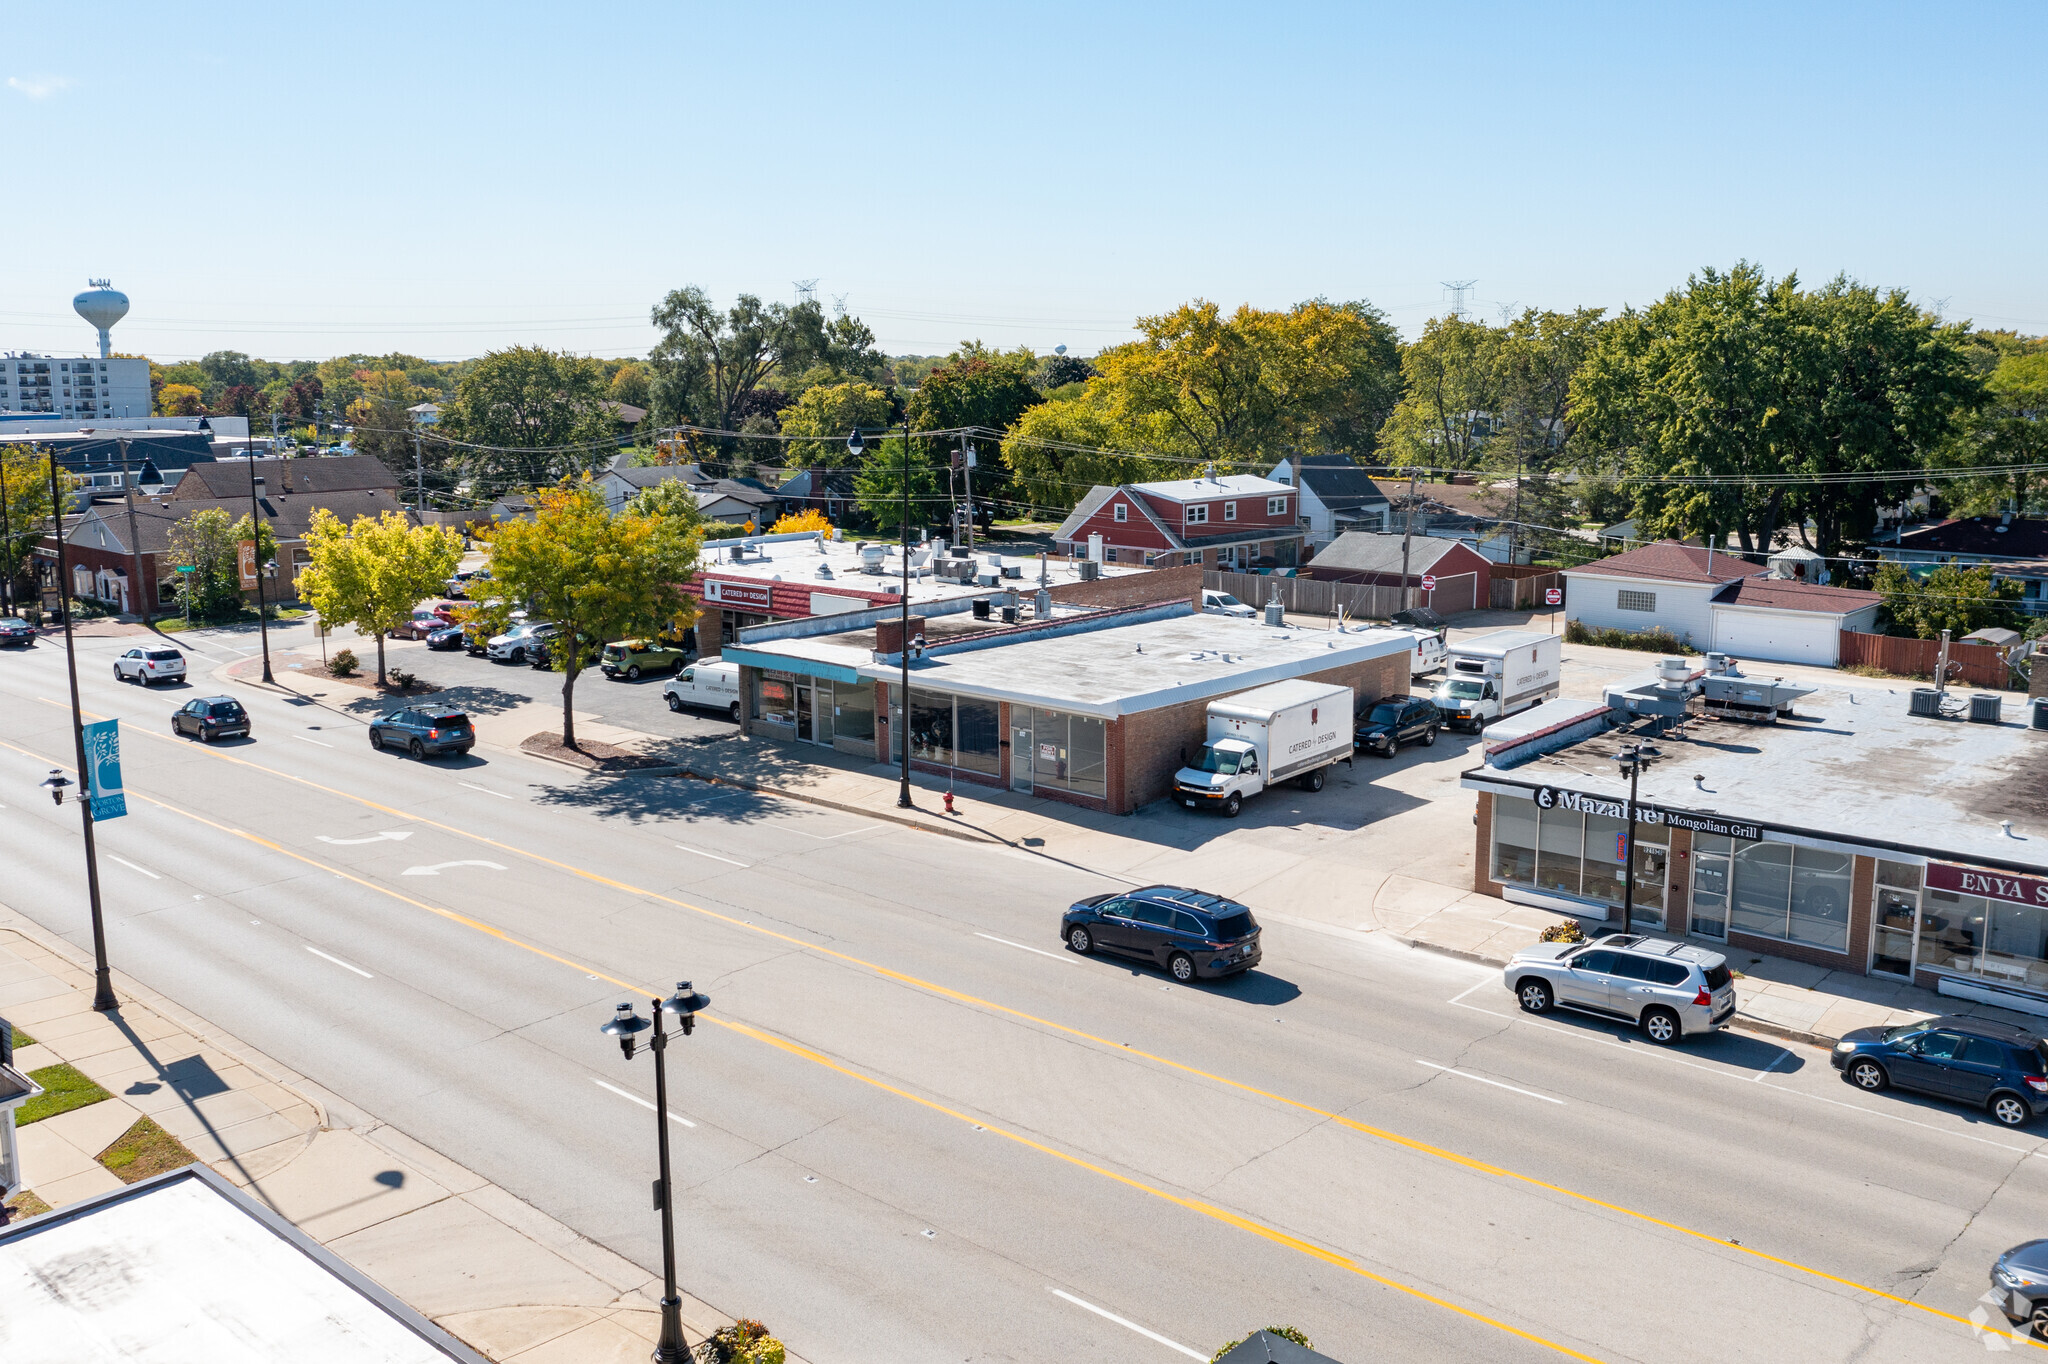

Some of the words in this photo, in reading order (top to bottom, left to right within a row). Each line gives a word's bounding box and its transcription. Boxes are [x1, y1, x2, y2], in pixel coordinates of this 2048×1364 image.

[722, 588, 743, 598] CATERED
[749, 592, 767, 600] DESIGN
[1516, 675, 1532, 686] CATERED
[1536, 670, 1549, 680] DESIGN
[1288, 739, 1312, 754] CATERED
[1317, 731, 1337, 745] DESIGN
[93, 803, 126, 817] GROVE
[1560, 790, 1658, 824] Mazalae
[1667, 814, 1728, 831] Mongolian
[1731, 825, 1757, 838] Grill
[1960, 872, 2026, 899] ENYA
